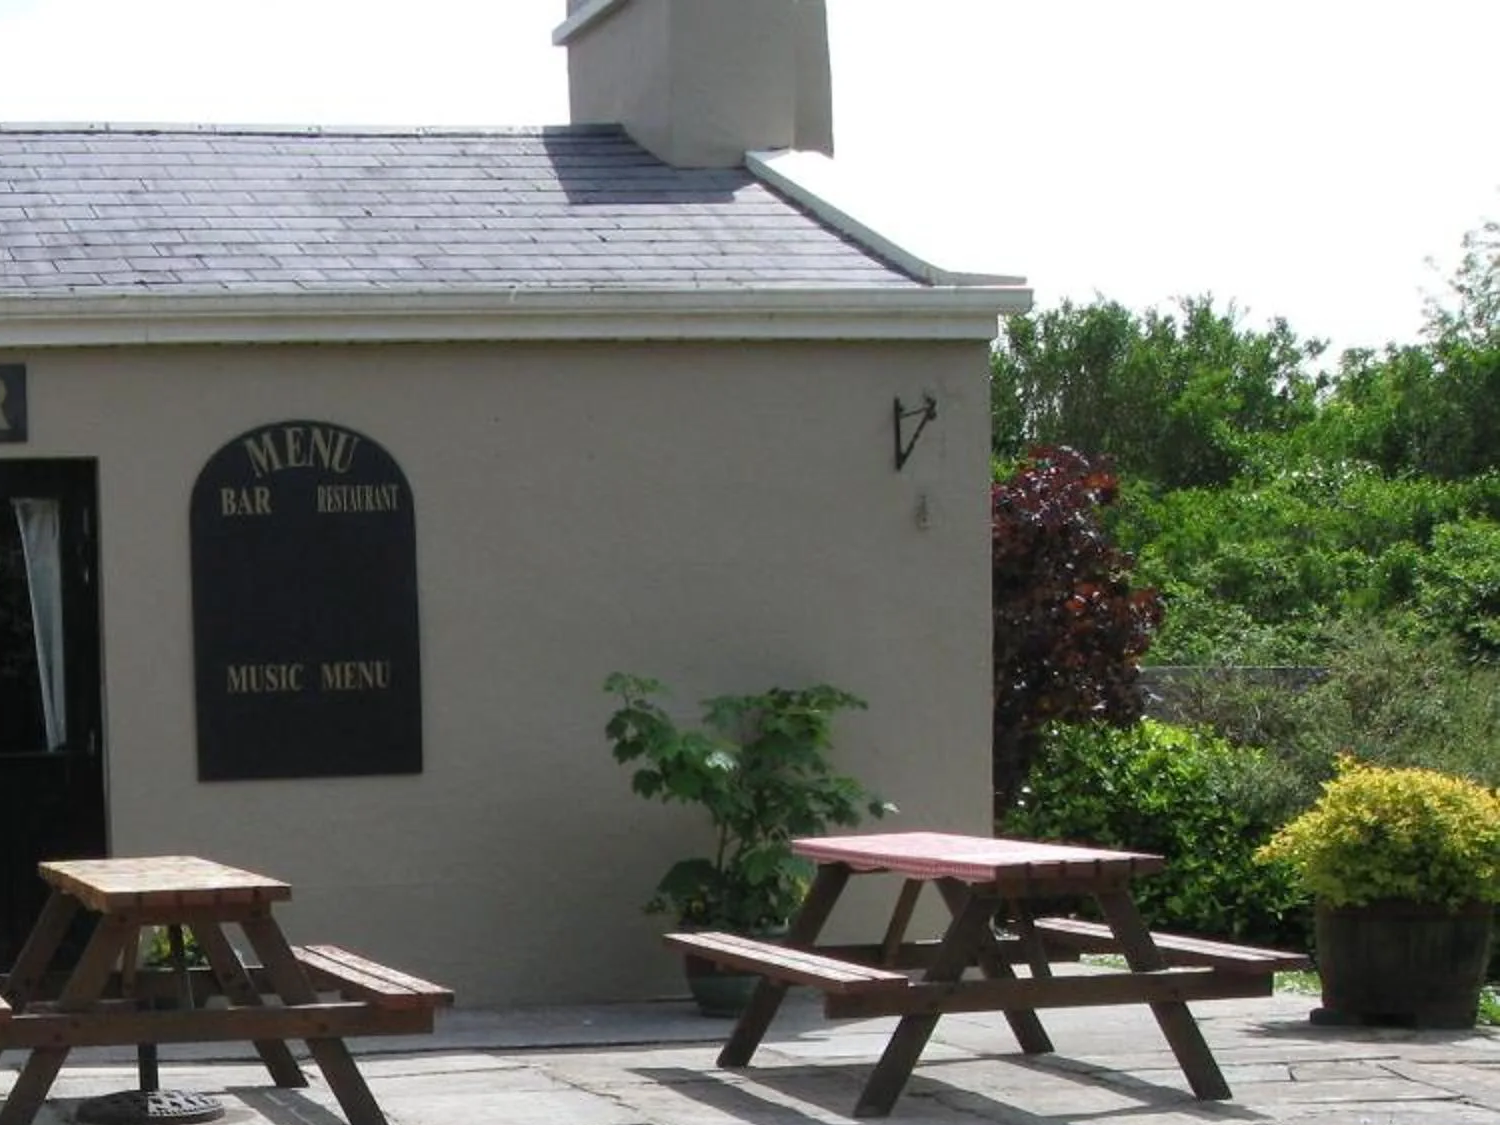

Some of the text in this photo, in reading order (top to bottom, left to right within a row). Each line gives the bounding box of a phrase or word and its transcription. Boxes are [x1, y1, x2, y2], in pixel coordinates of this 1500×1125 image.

[244, 427, 360, 477] MENU
[220, 487, 271, 516] BAR
[317, 484, 398, 513] RESTAURANT
[227, 661, 390, 693] MUSIC MENU
